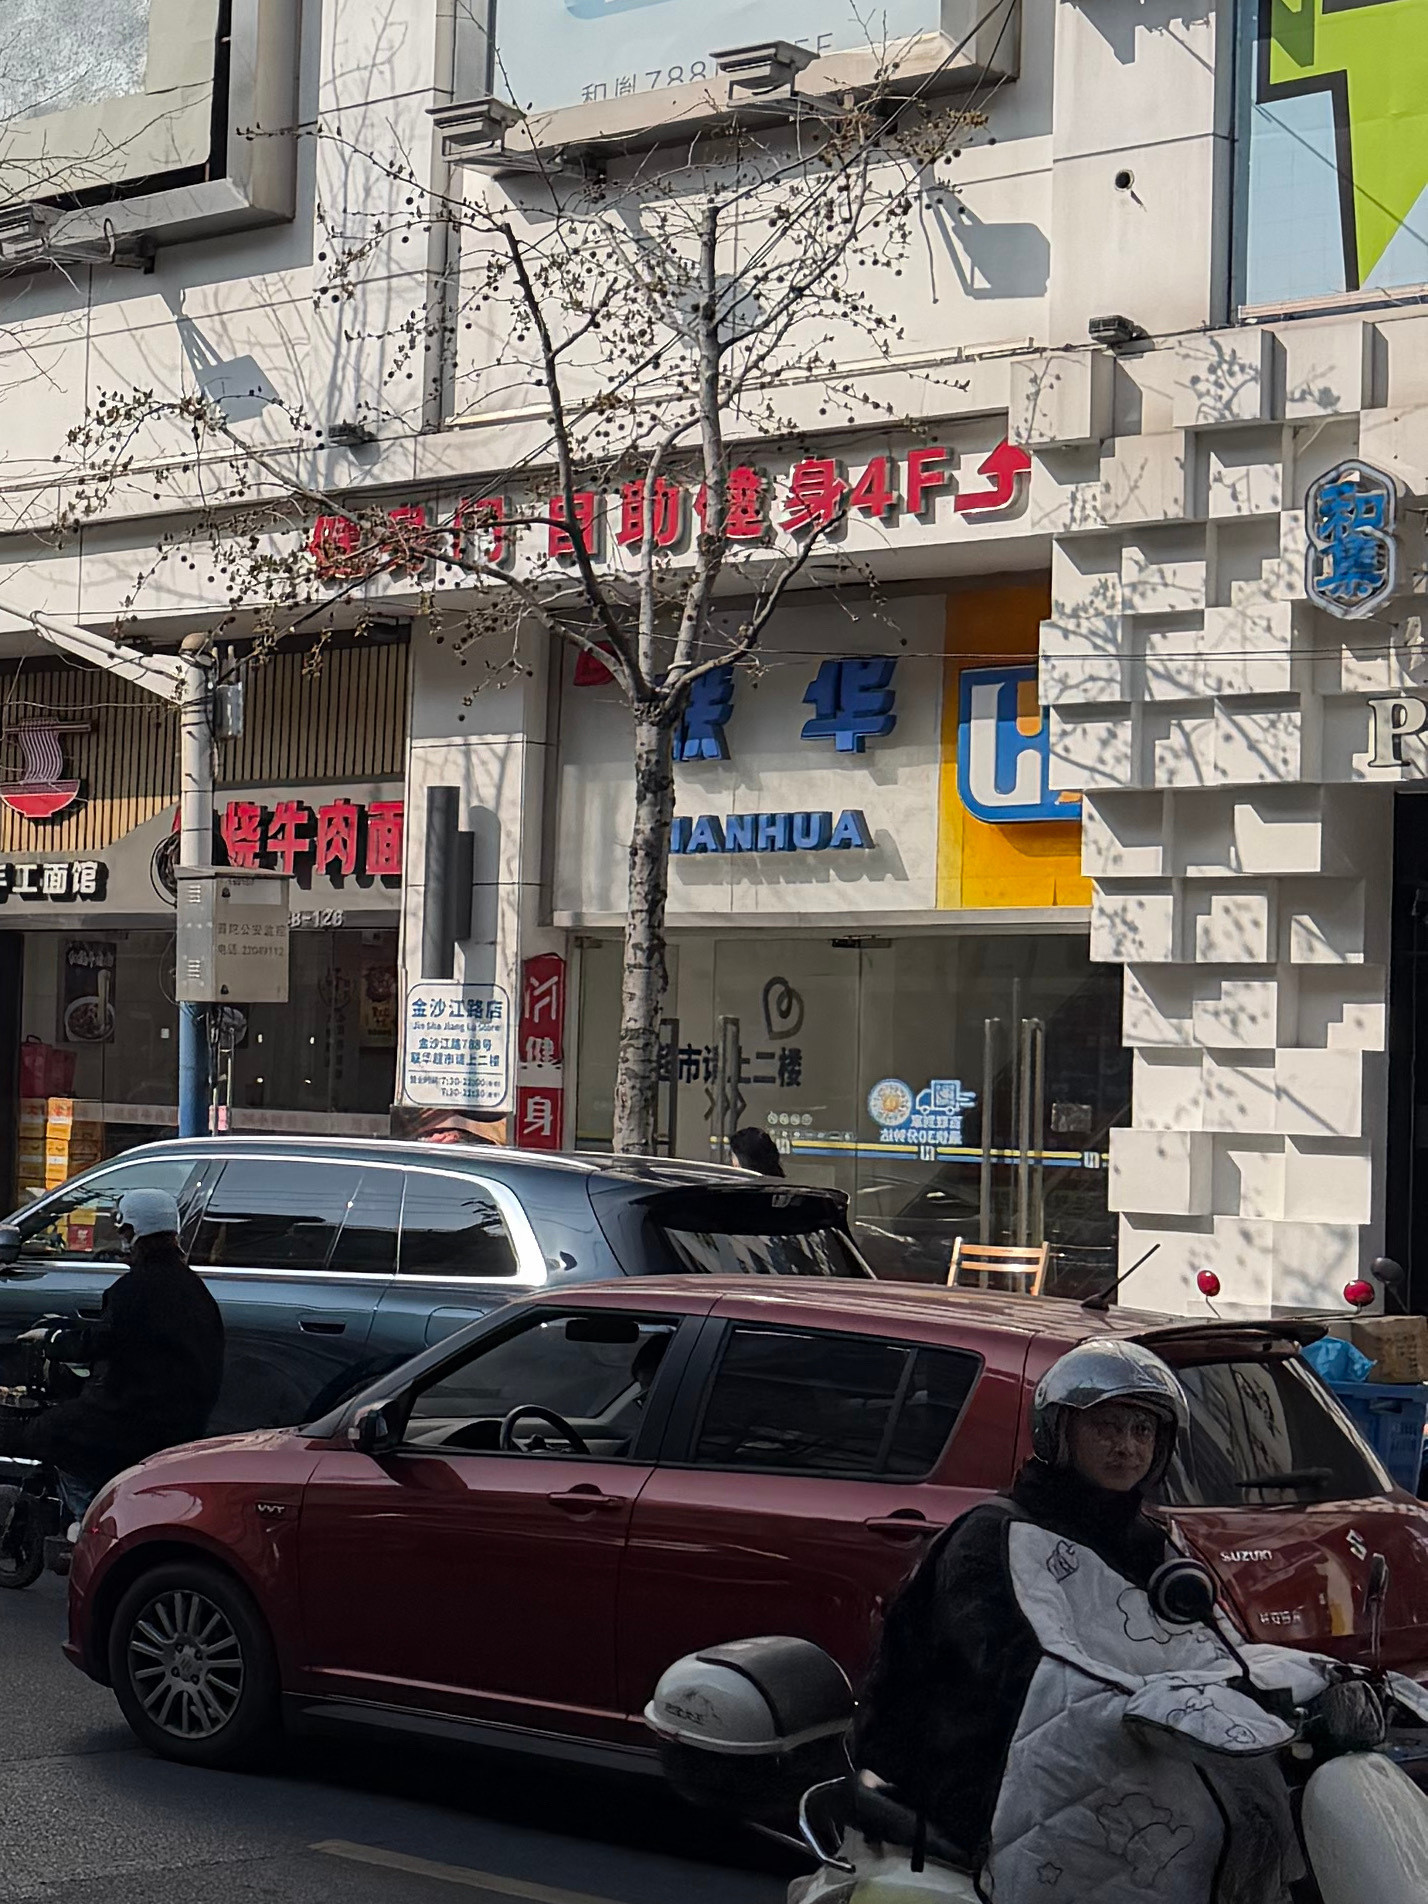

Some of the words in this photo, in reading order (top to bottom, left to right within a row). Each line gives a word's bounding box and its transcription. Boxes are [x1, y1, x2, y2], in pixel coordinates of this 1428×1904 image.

[173, 798, 405, 878] 烧牛肉面
[411, 997, 504, 1020] 金沙江路店
